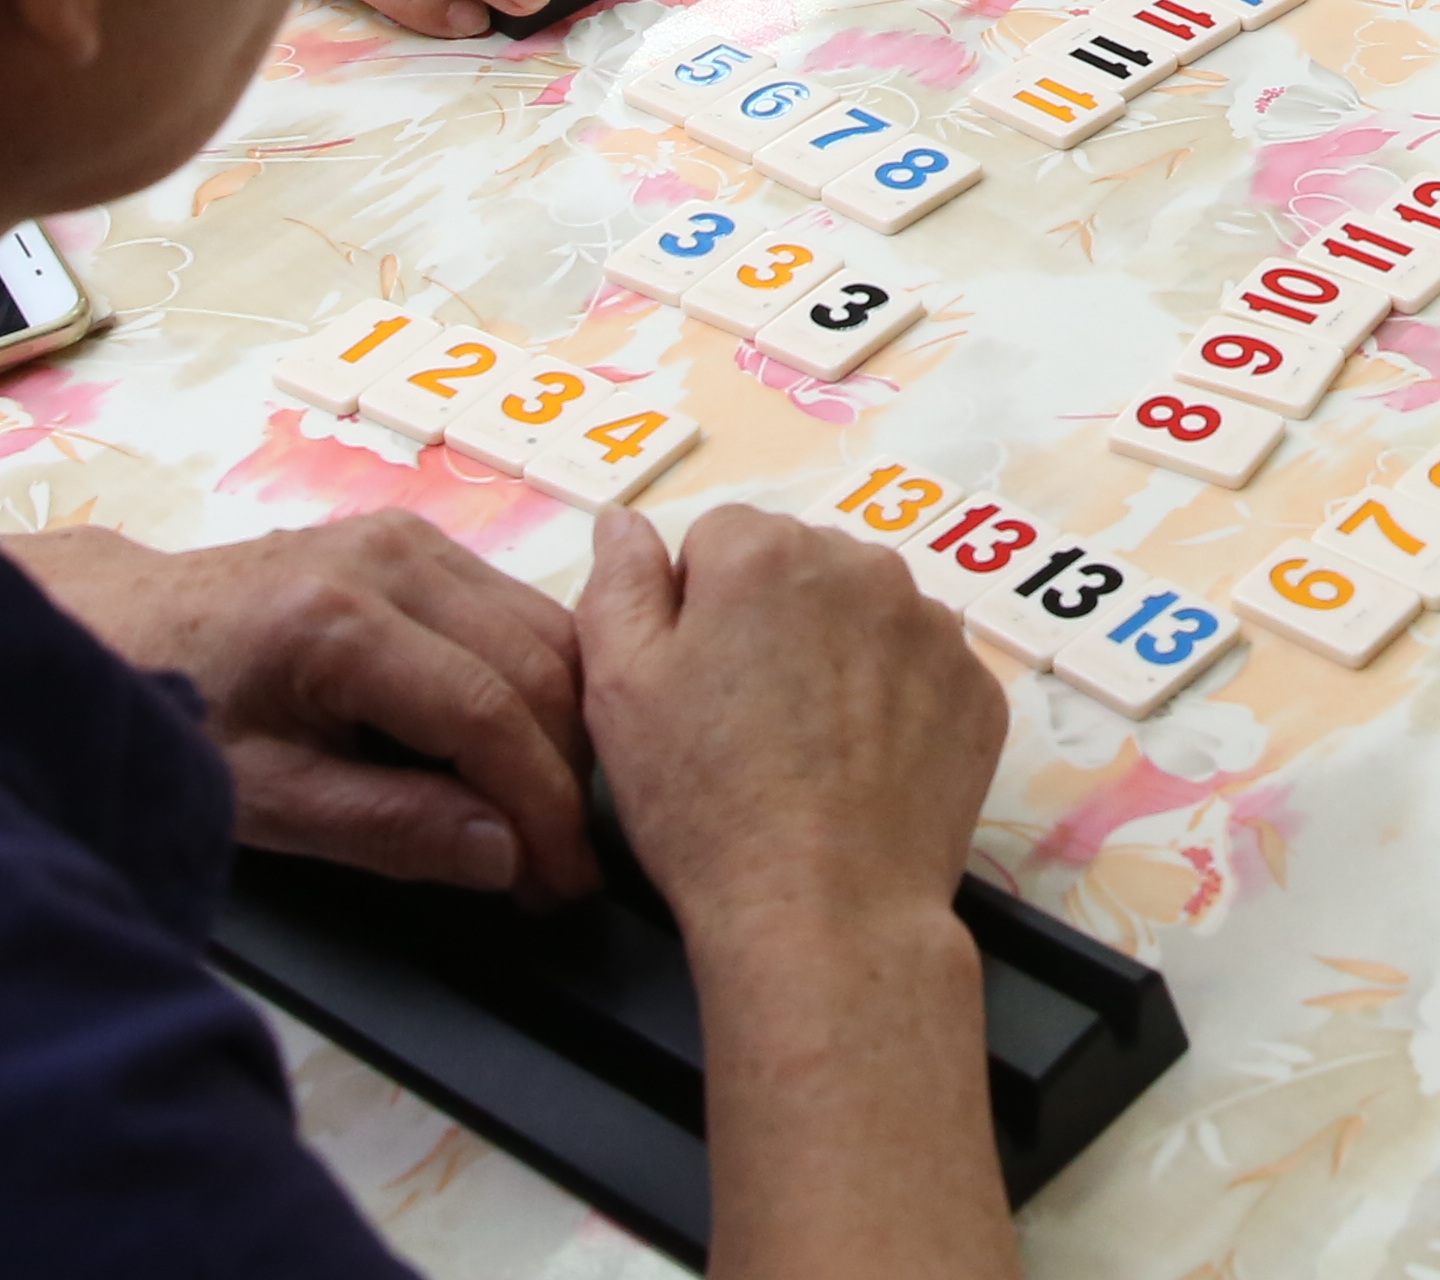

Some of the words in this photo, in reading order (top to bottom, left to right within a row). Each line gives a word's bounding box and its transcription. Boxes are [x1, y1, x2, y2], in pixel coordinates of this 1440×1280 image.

[676, 46, 750, 85] 5
[741, 82, 810, 120] 6
[812, 109, 890, 149] 7
[875, 149, 950, 190] 8
[1016, 79, 1096, 122] 11
[1070, 36, 1151, 79] 11
[1136, 0, 1215, 40] 11
[659, 214, 736, 258] 3
[739, 245, 812, 289] 3
[811, 284, 888, 329] 3
[1138, 396, 1221, 441] 8
[1202, 335, 1283, 375] 9
[1243, 268, 1339, 323] 10
[1324, 224, 1413, 271] 11
[342, 317, 409, 362] 1
[410, 344, 495, 398] 2
[503, 373, 584, 424] 3
[586, 412, 667, 463] 4
[838, 466, 942, 531] 13
[930, 505, 1037, 573] 13
[1015, 548, 1123, 618] 13
[1108, 592, 1219, 666] 13
[1271, 560, 1354, 610] 6
[1339, 501, 1424, 555] 7
